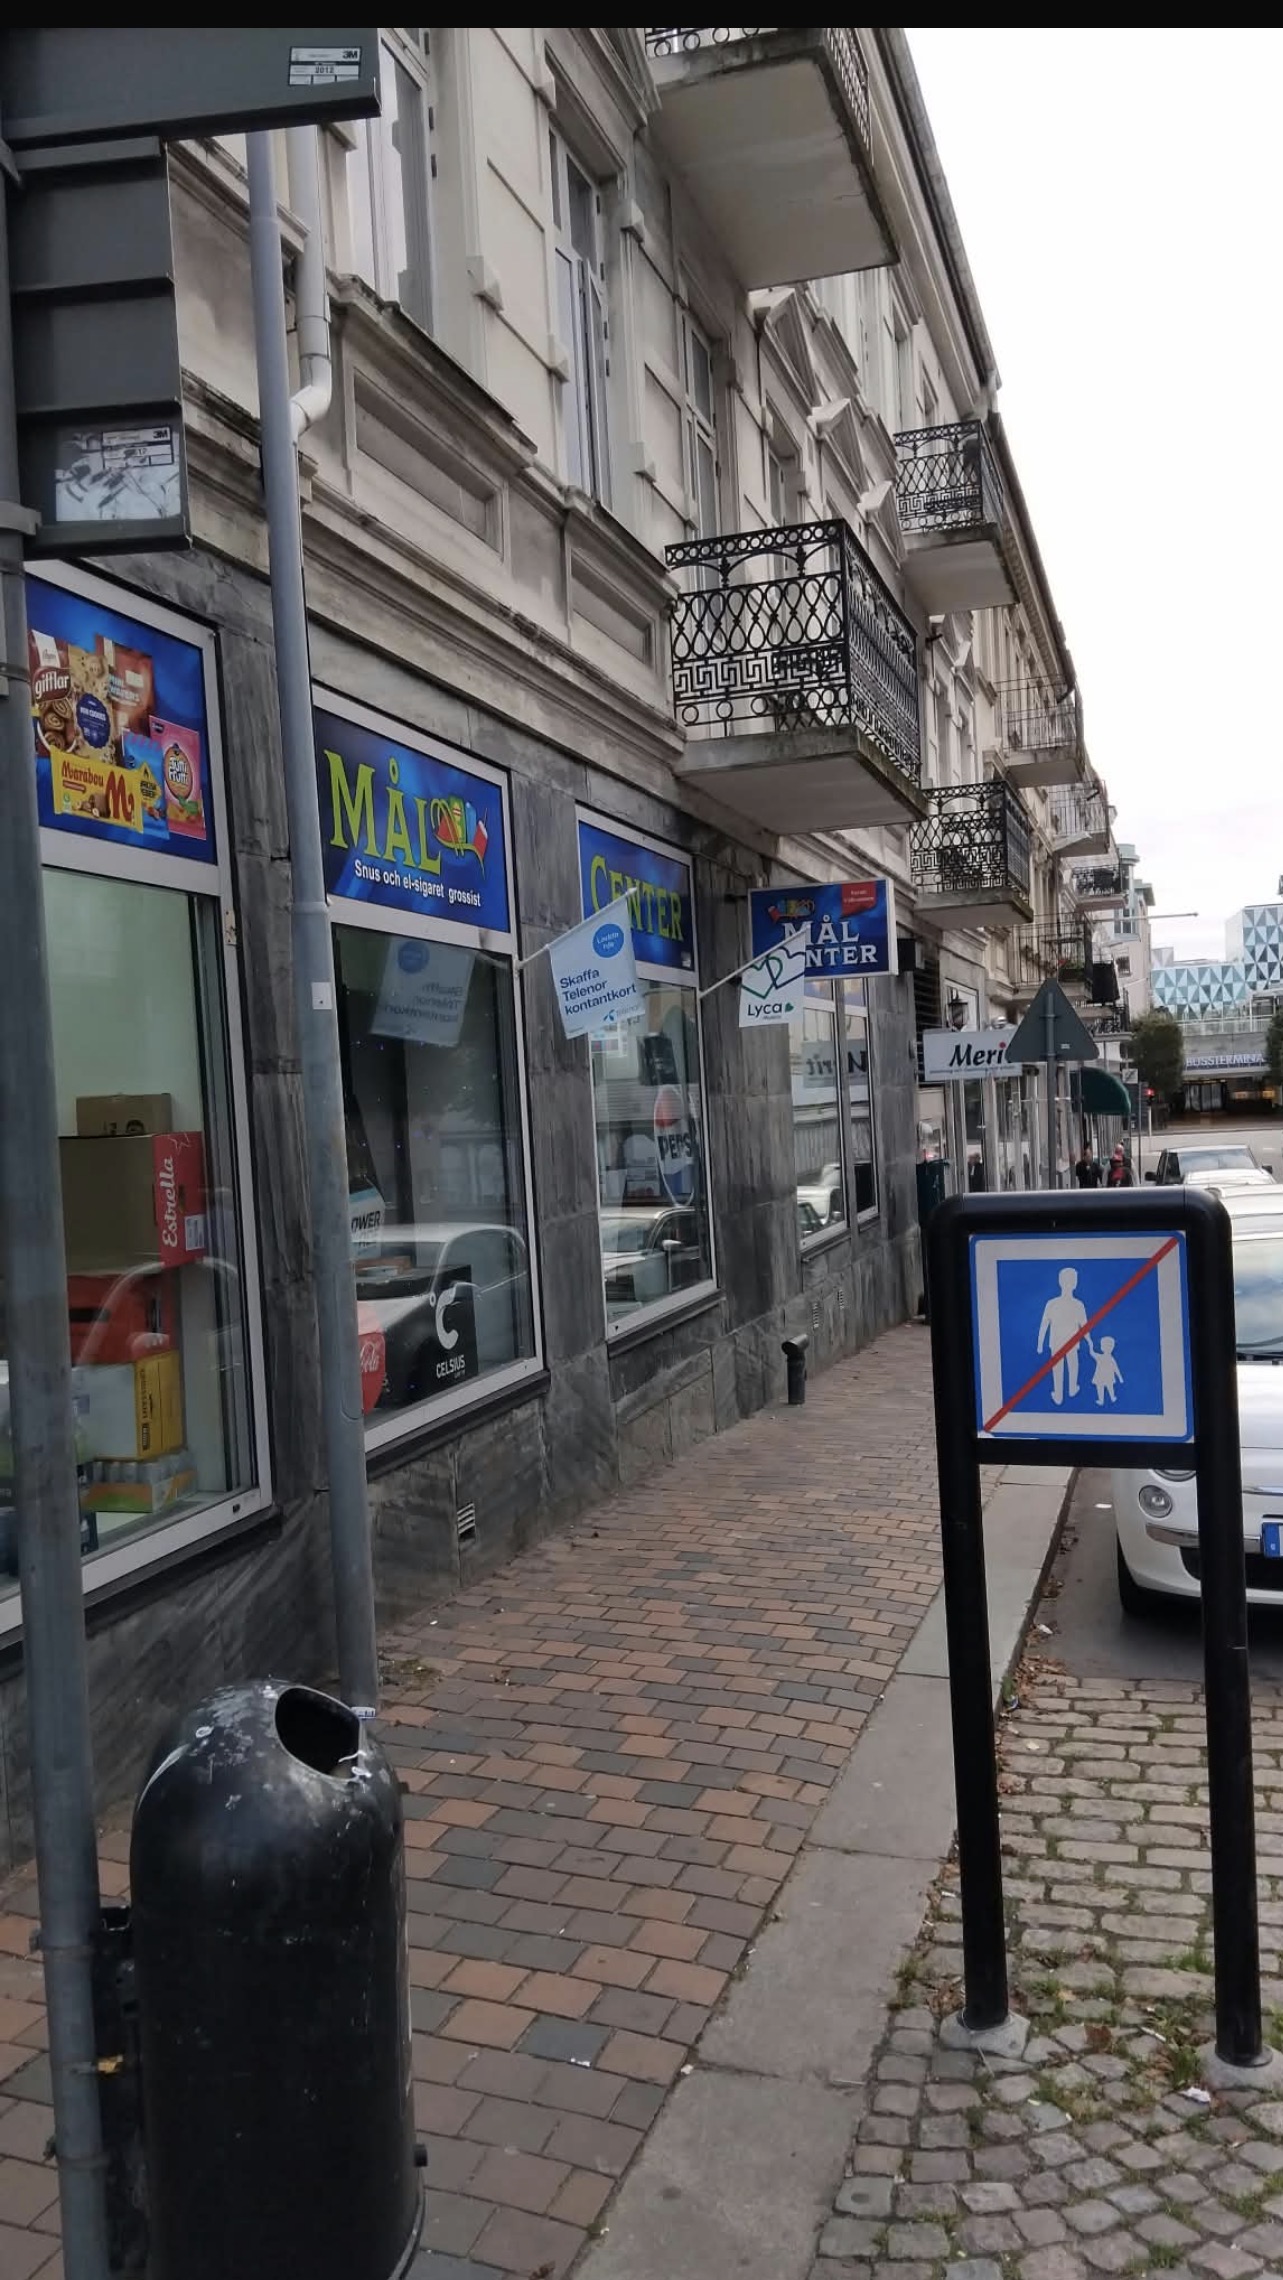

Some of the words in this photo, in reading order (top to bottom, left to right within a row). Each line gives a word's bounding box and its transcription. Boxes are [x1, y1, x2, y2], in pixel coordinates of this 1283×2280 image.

[342, 50, 358, 59] 3M
[152, 429, 169, 439] 3M
[61, 760, 104, 787] Marabou
[324, 749, 441, 876] MÅL
[354, 859, 381, 883] Snus
[383, 870, 401, 887] och
[403, 873, 445, 898] el-sigaret
[448, 887, 481, 907] grossist
[782, 914, 860, 946] MÅL
[805, 944, 878, 969] NTER
[560, 968, 600, 989] Skaffa
[562, 980, 608, 1002] Telenor
[564, 983, 637, 1016] kontantkort
[747, 1002, 783, 1018] Lyca
[949, 1042, 1008, 1067] Meri
[1186, 1053, 1269, 1068] BUSSTERMINA
[657, 1132, 693, 1161] PEPS
[159, 1155, 179, 1248] Estrella
[350, 1210, 381, 1233] OWER
[436, 1355, 466, 1379] CELSIUS
